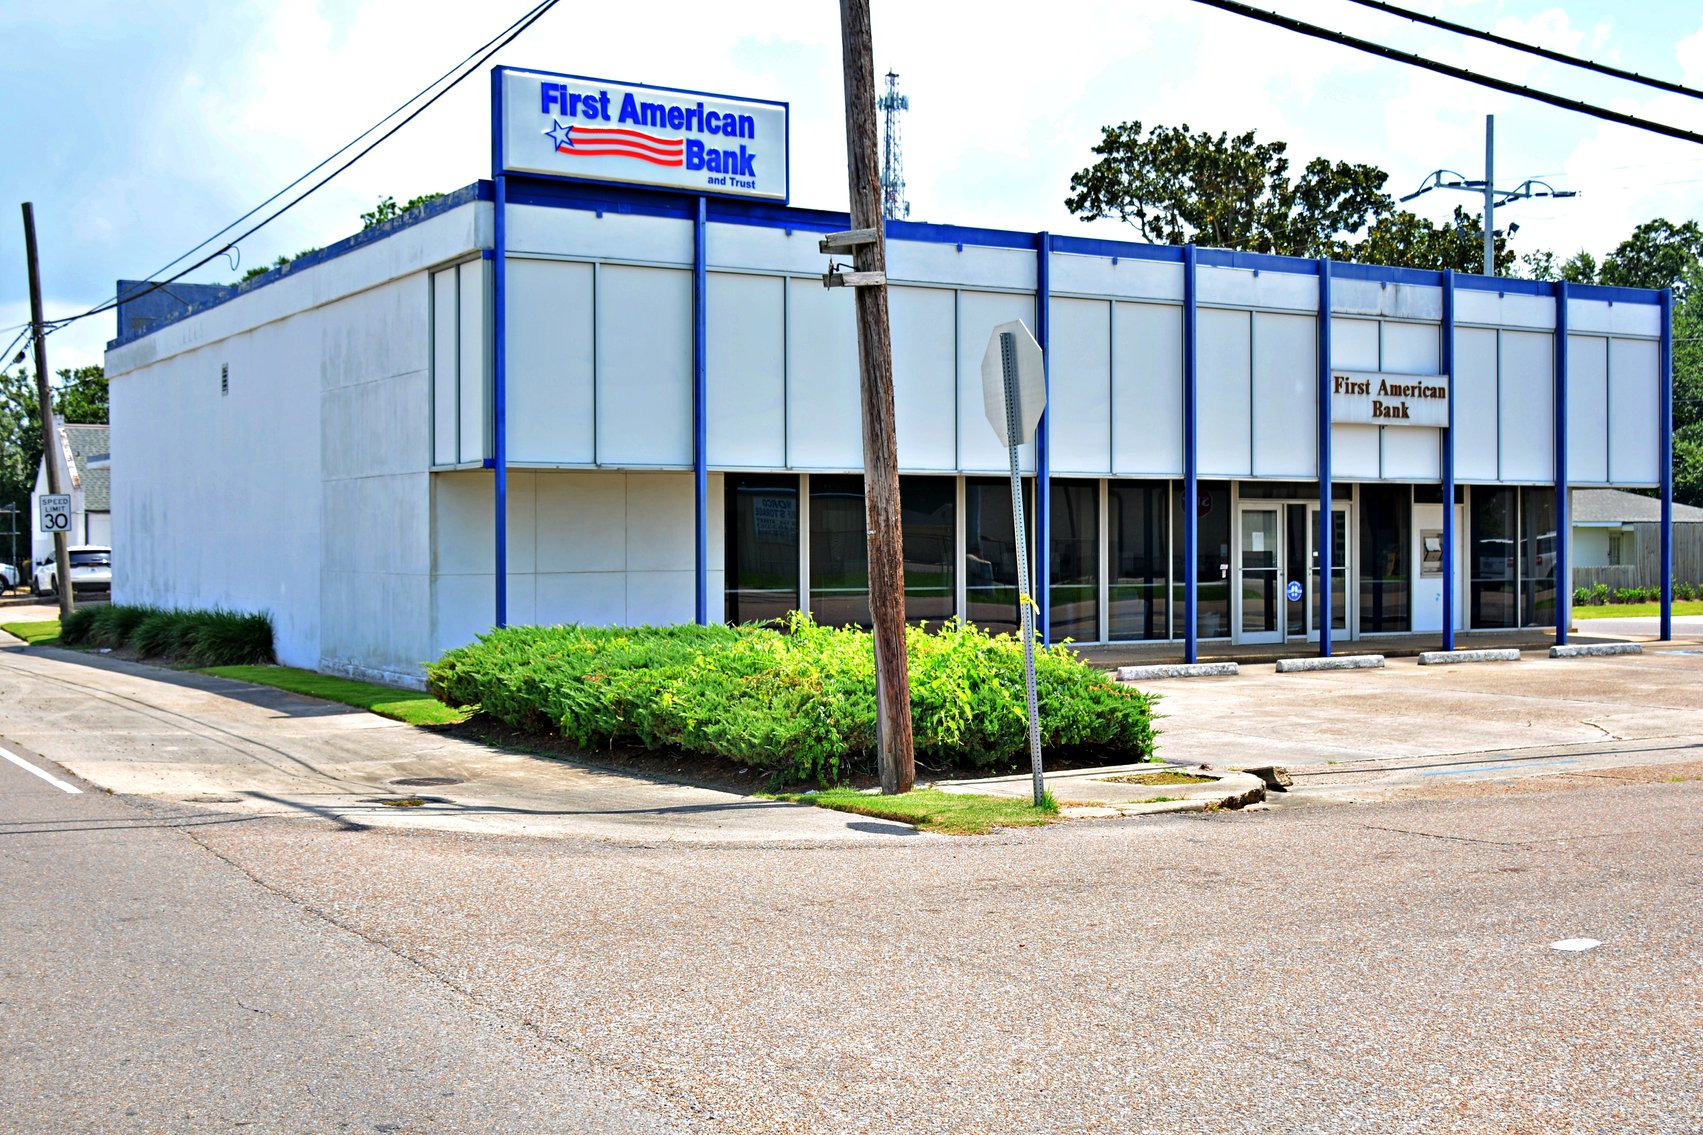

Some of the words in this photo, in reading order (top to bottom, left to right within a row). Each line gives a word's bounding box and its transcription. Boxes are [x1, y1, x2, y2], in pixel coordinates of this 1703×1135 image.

[541, 81, 611, 121] First
[619, 93, 755, 139] American
[686, 138, 756, 177] Bank
[707, 175, 727, 186] and
[729, 177, 756, 189] Trust
[1333, 376, 1371, 395] First
[1377, 379, 1446, 399] American
[1372, 400, 1410, 419] Bank
[42, 498, 68, 506] SPEED
[45, 513, 68, 529] 30
